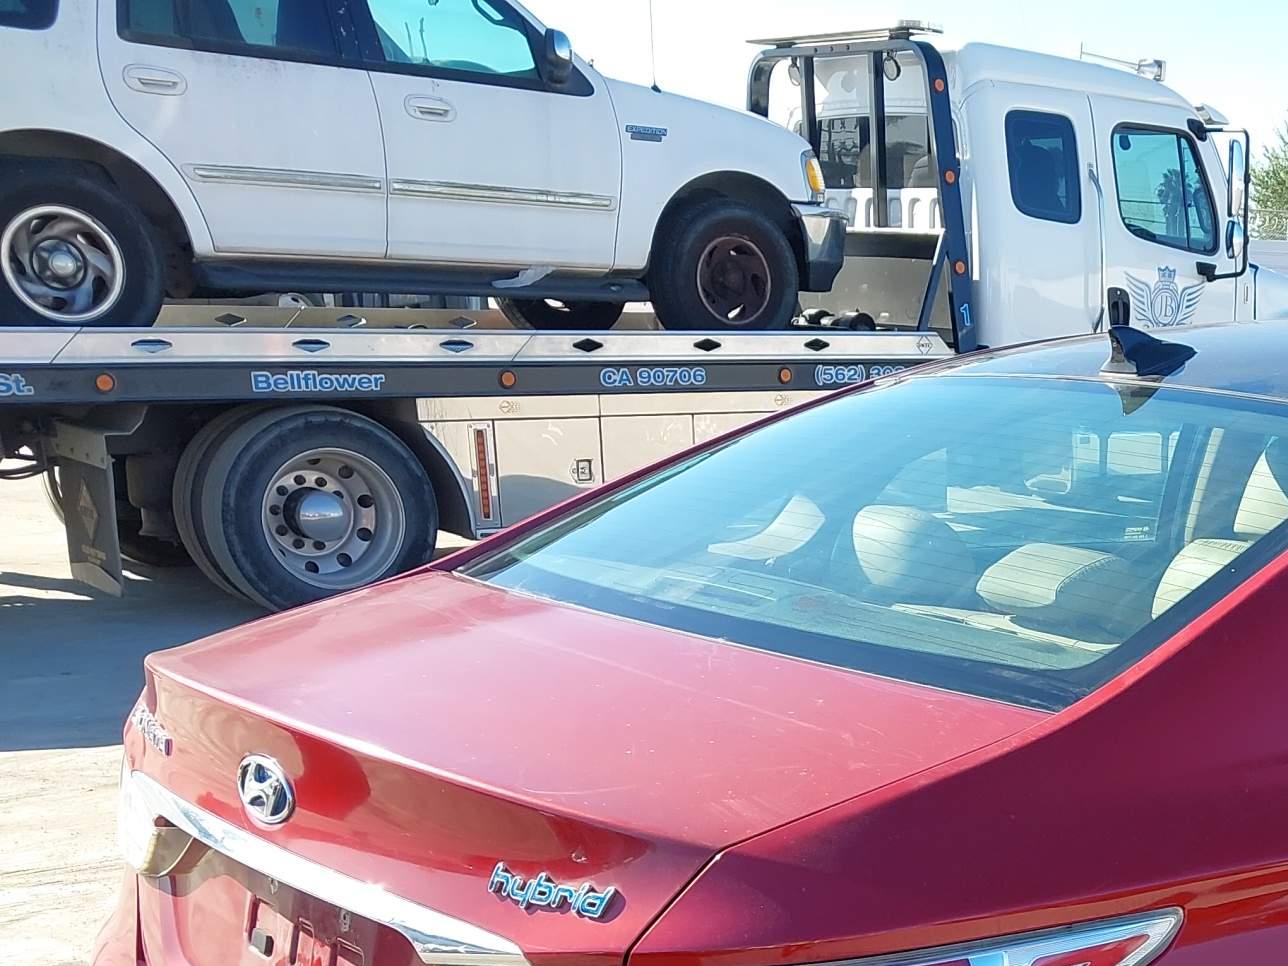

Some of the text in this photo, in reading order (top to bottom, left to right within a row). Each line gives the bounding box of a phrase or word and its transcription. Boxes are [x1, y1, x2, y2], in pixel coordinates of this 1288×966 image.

[626, 125, 668, 136] EXPEDITION
[960, 303, 971, 326] 1
[251, 371, 385, 392] Bellflower
[600, 367, 706, 387] CA 90706
[814, 364, 866, 386] (562)
[488, 861, 616, 918] hybrid
